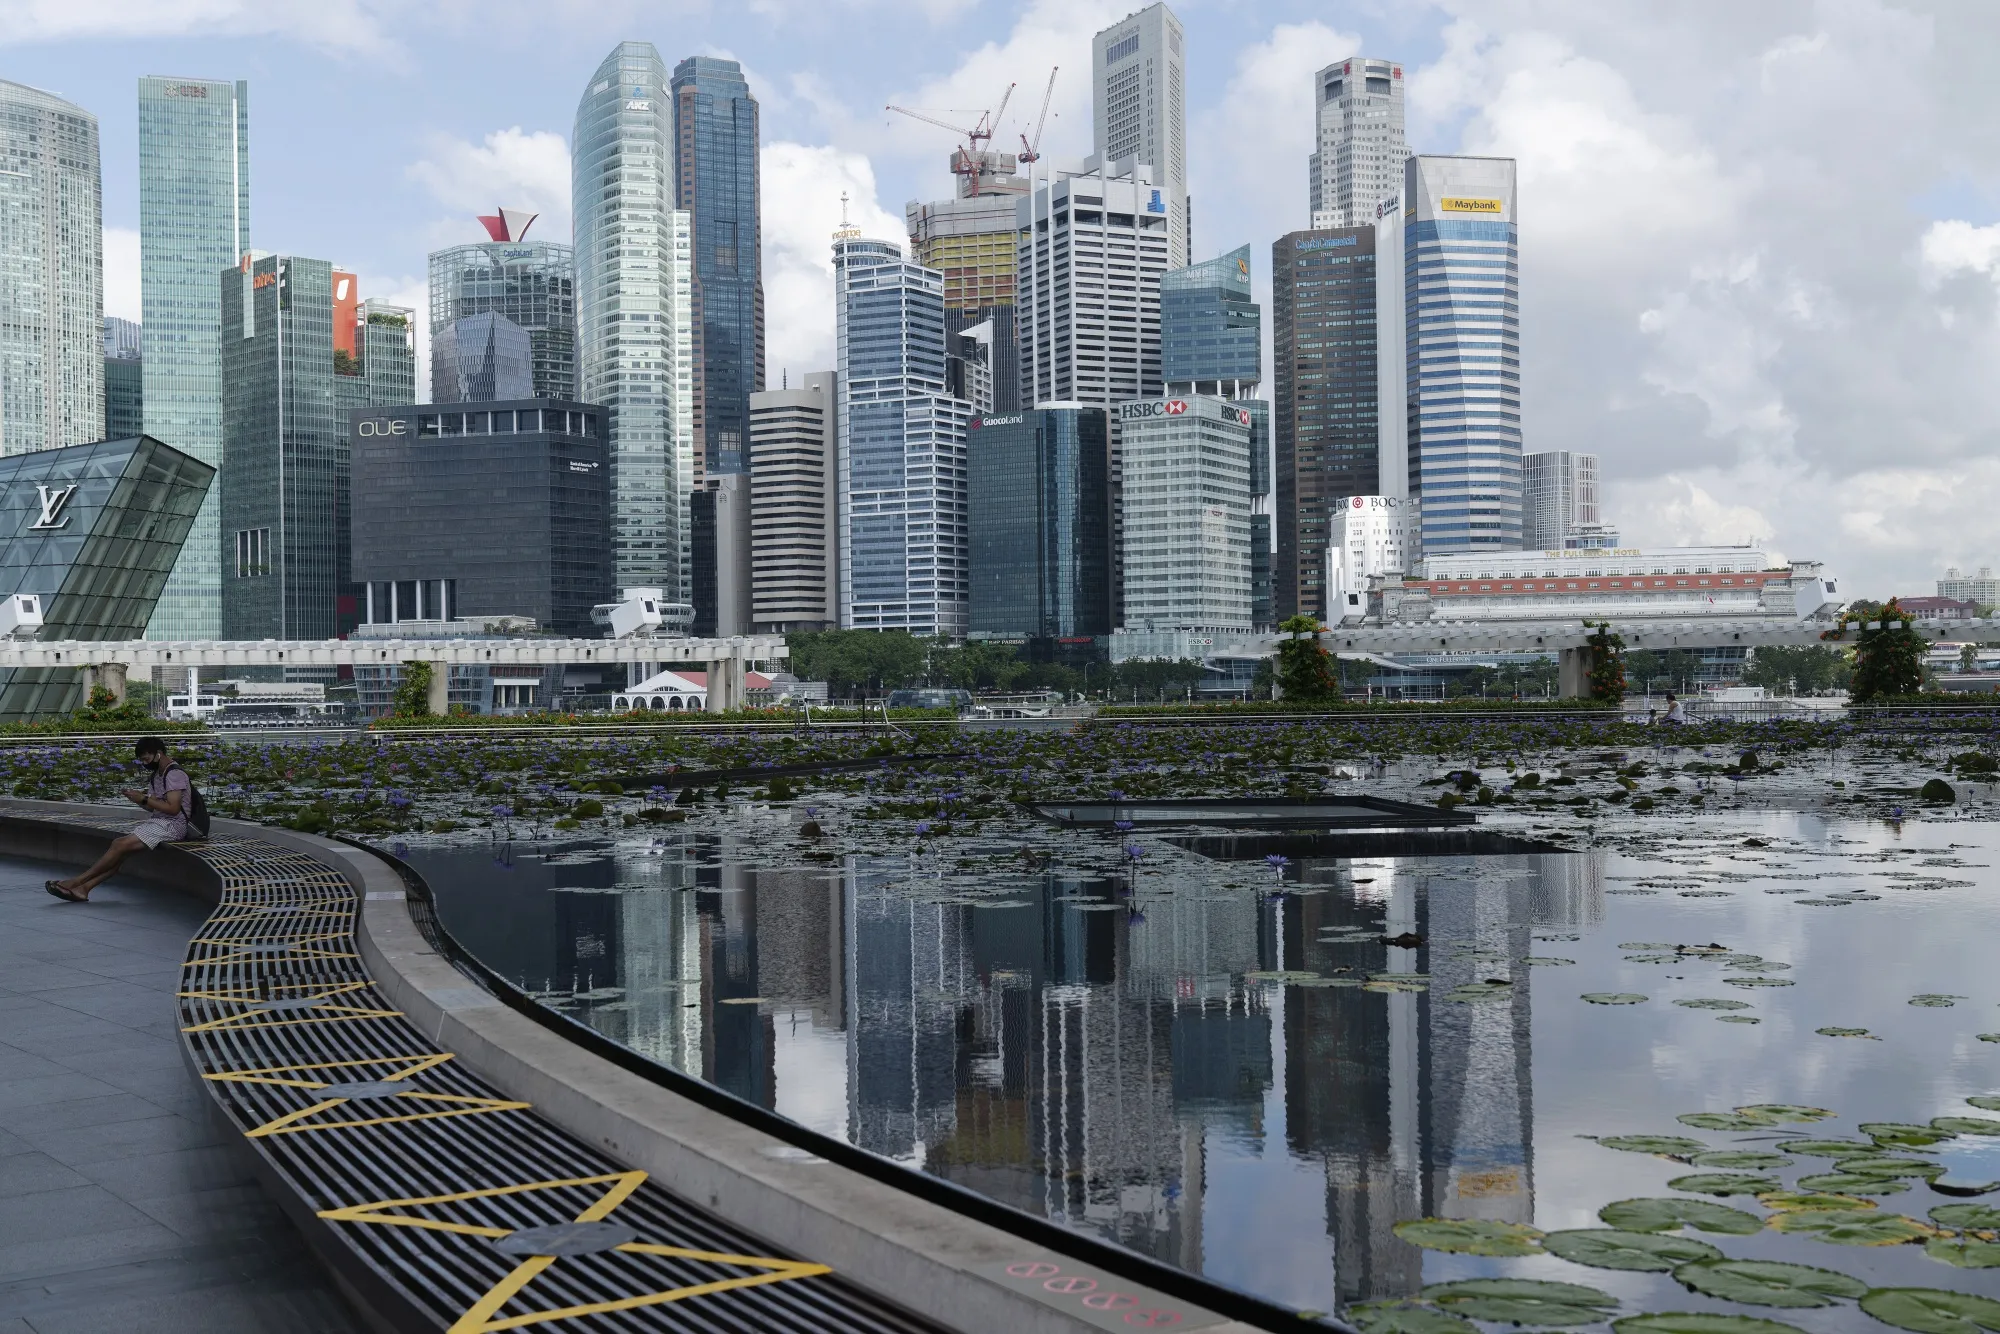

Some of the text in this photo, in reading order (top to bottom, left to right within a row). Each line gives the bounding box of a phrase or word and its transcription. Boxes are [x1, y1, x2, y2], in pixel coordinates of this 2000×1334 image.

[180, 86, 206, 98] UBS
[625, 101, 650, 111] ANZ
[1455, 200, 1496, 210] Maybank
[504, 248, 532, 257] CapitaLand
[1186, 270, 1209, 278] MYP
[1121, 402, 1164, 418] HSBC
[1221, 405, 1239, 422] HSBC
[983, 415, 1023, 426] GuocoLand
[359, 420, 406, 436] OUE
[1337, 499, 1349, 511] BOC
[1371, 497, 1396, 507] BOC
[1563, 549, 1610, 557] FULLERTON
[1613, 548, 1641, 556] HOTEL
